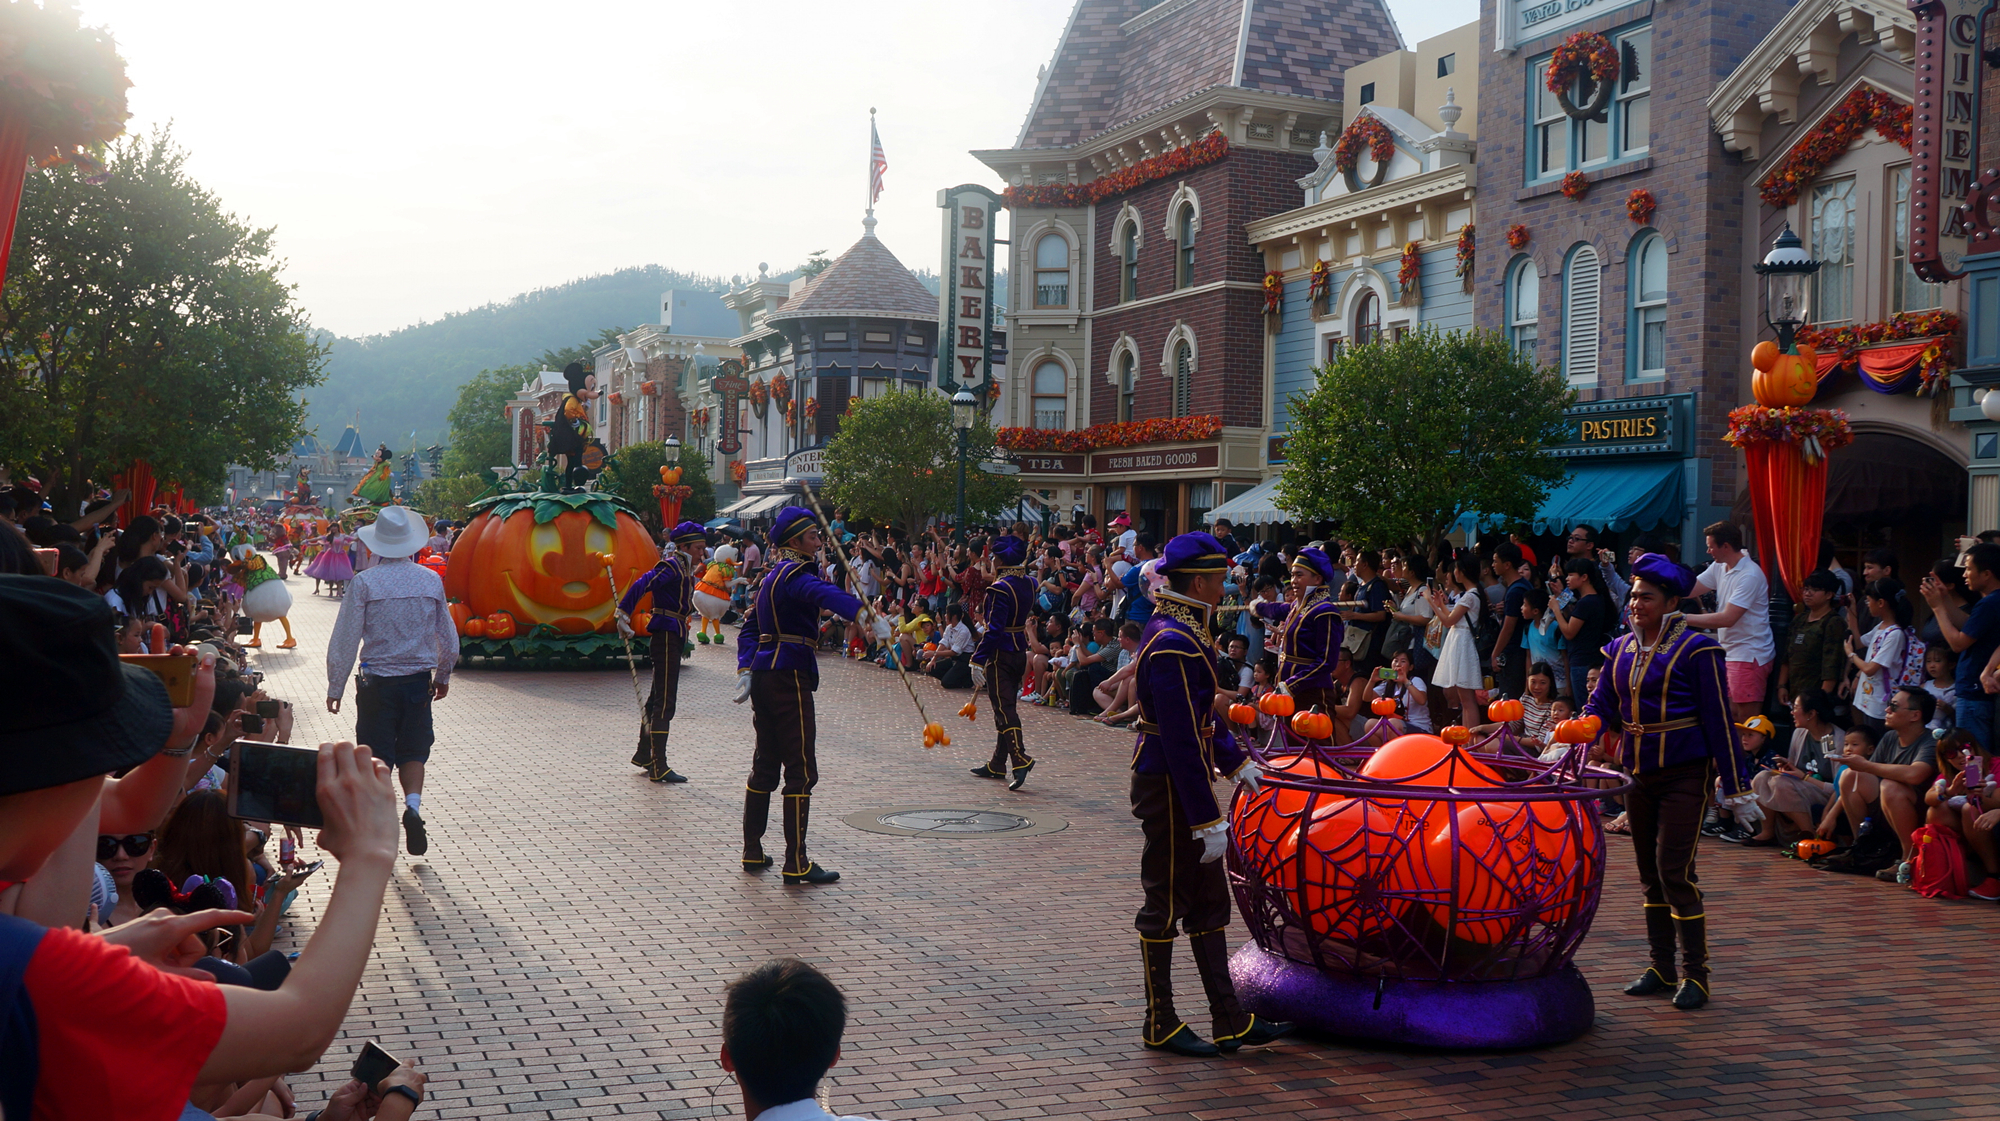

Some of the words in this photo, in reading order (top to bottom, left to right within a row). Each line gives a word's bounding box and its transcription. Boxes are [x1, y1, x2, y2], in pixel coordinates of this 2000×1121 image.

[1523, 1, 1561, 24] WARD
[1942, 14, 1977, 238] CINEMA
[957, 205, 985, 378] BAKERY
[719, 380, 745, 389] Fine
[726, 389, 736, 449] COLLECTIBLES
[1581, 416, 1657, 441] PASTRIES
[1028, 459, 1064, 469] TEA
[1108, 457, 1133, 468] FRESH
[1135, 455, 1162, 467] BAKED
[1165, 453, 1198, 465] GOODS
